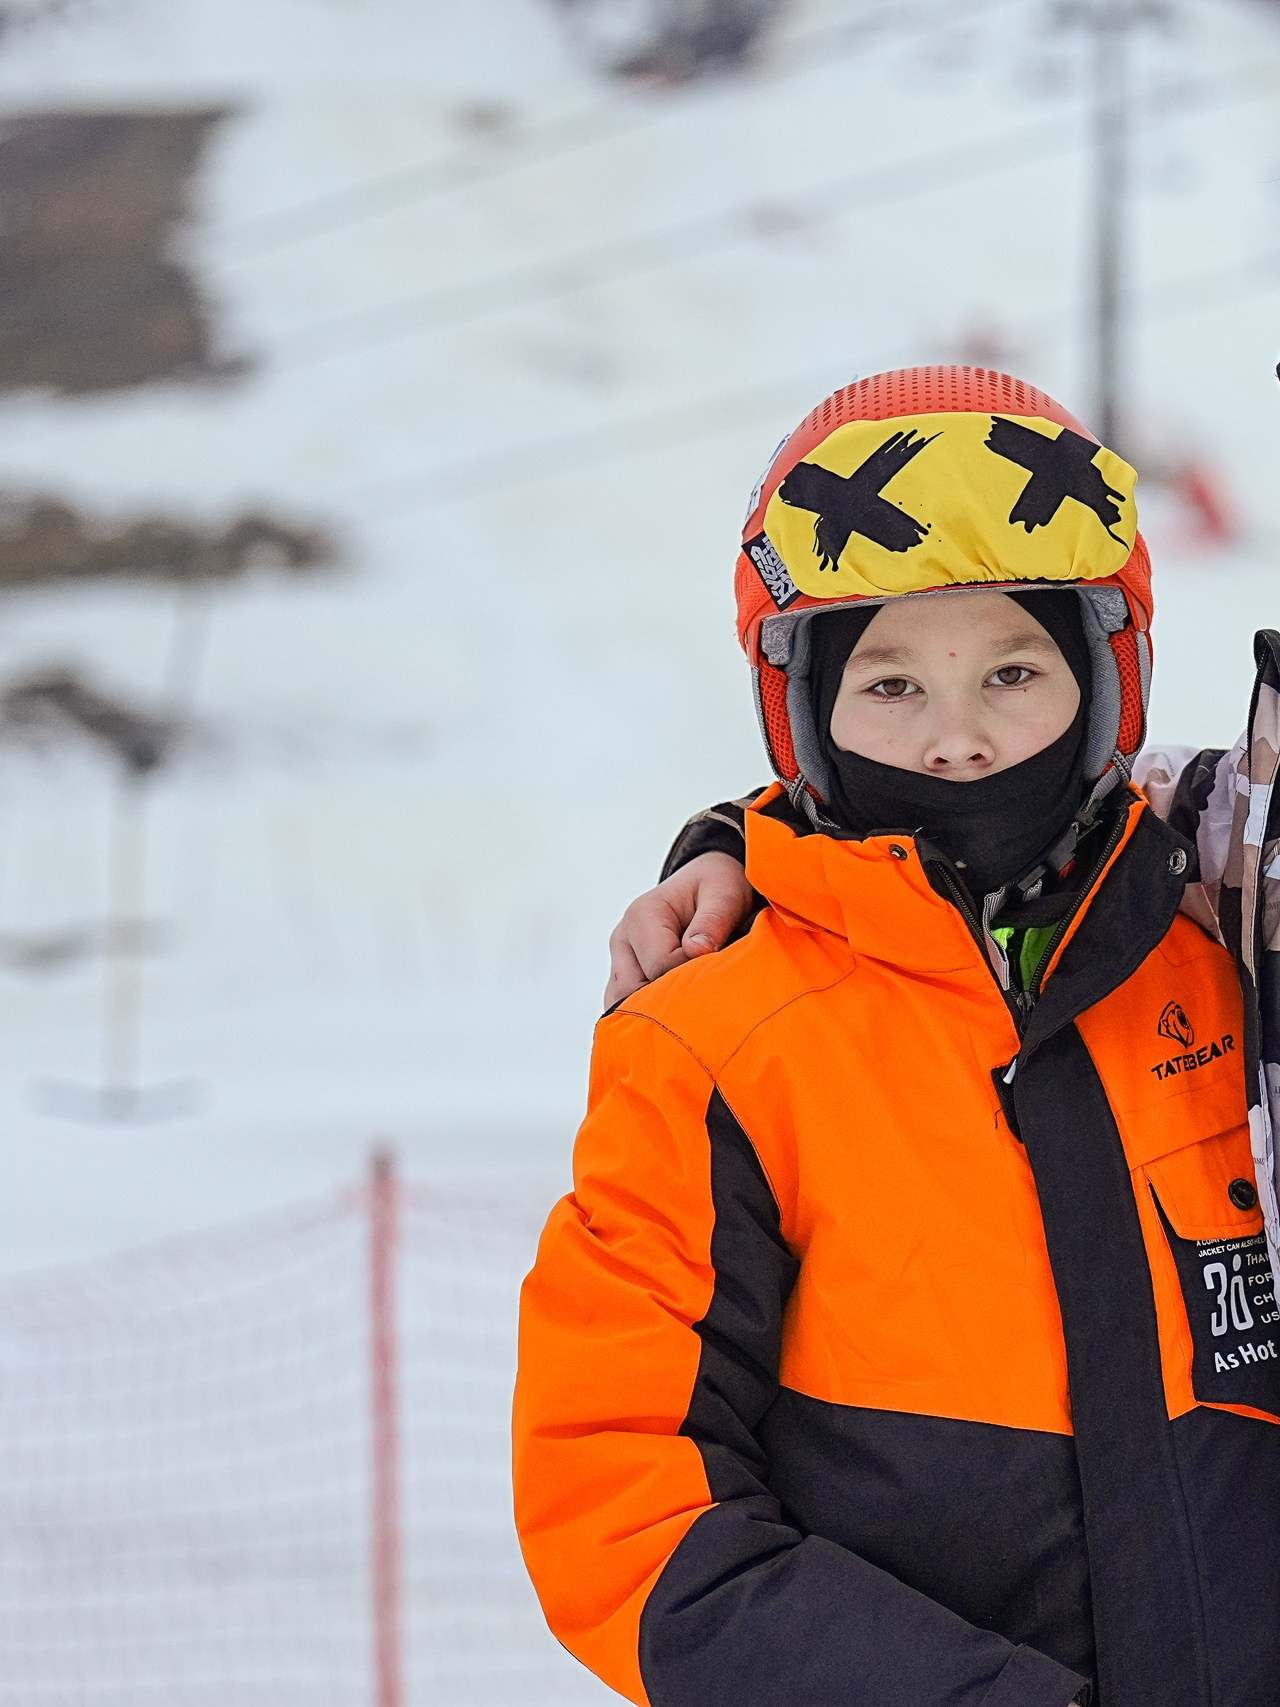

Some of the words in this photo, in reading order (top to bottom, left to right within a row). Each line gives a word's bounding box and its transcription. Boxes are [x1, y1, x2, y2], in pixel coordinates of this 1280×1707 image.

[1151, 1034, 1236, 1080] TATEBEAR
[1198, 1245, 1225, 1258] JACKET
[1226, 1242, 1240, 1252] CAN
[1241, 1238, 1253, 1249] ALSO
[1248, 1272, 1274, 1286] FOR
[1214, 1351, 1240, 1373] As
[1237, 1339, 1278, 1364] Hot
